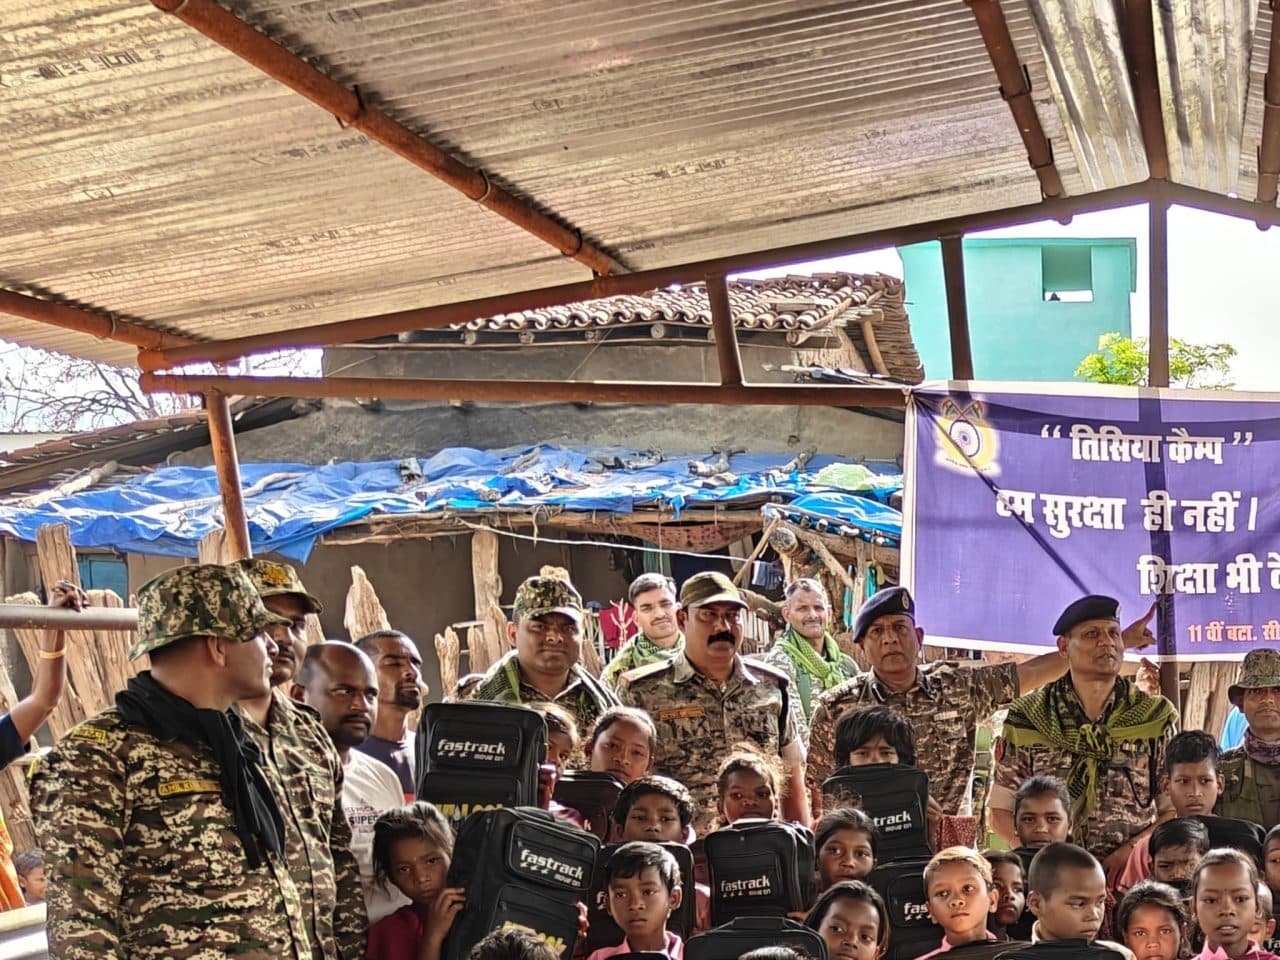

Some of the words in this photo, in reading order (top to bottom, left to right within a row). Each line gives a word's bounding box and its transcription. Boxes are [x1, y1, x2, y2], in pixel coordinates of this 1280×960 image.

[1040, 493, 1127, 539] सुरक्षा
[1141, 491, 1178, 532] ही
[1180, 490, 1241, 532] नहीं
[1224, 552, 1263, 595] भी
[1188, 624, 1202, 642] 11
[438, 739, 505, 755] fastrack
[873, 810, 911, 827] track
[520, 849, 583, 879] fastrack
[720, 875, 771, 892] fastrack
